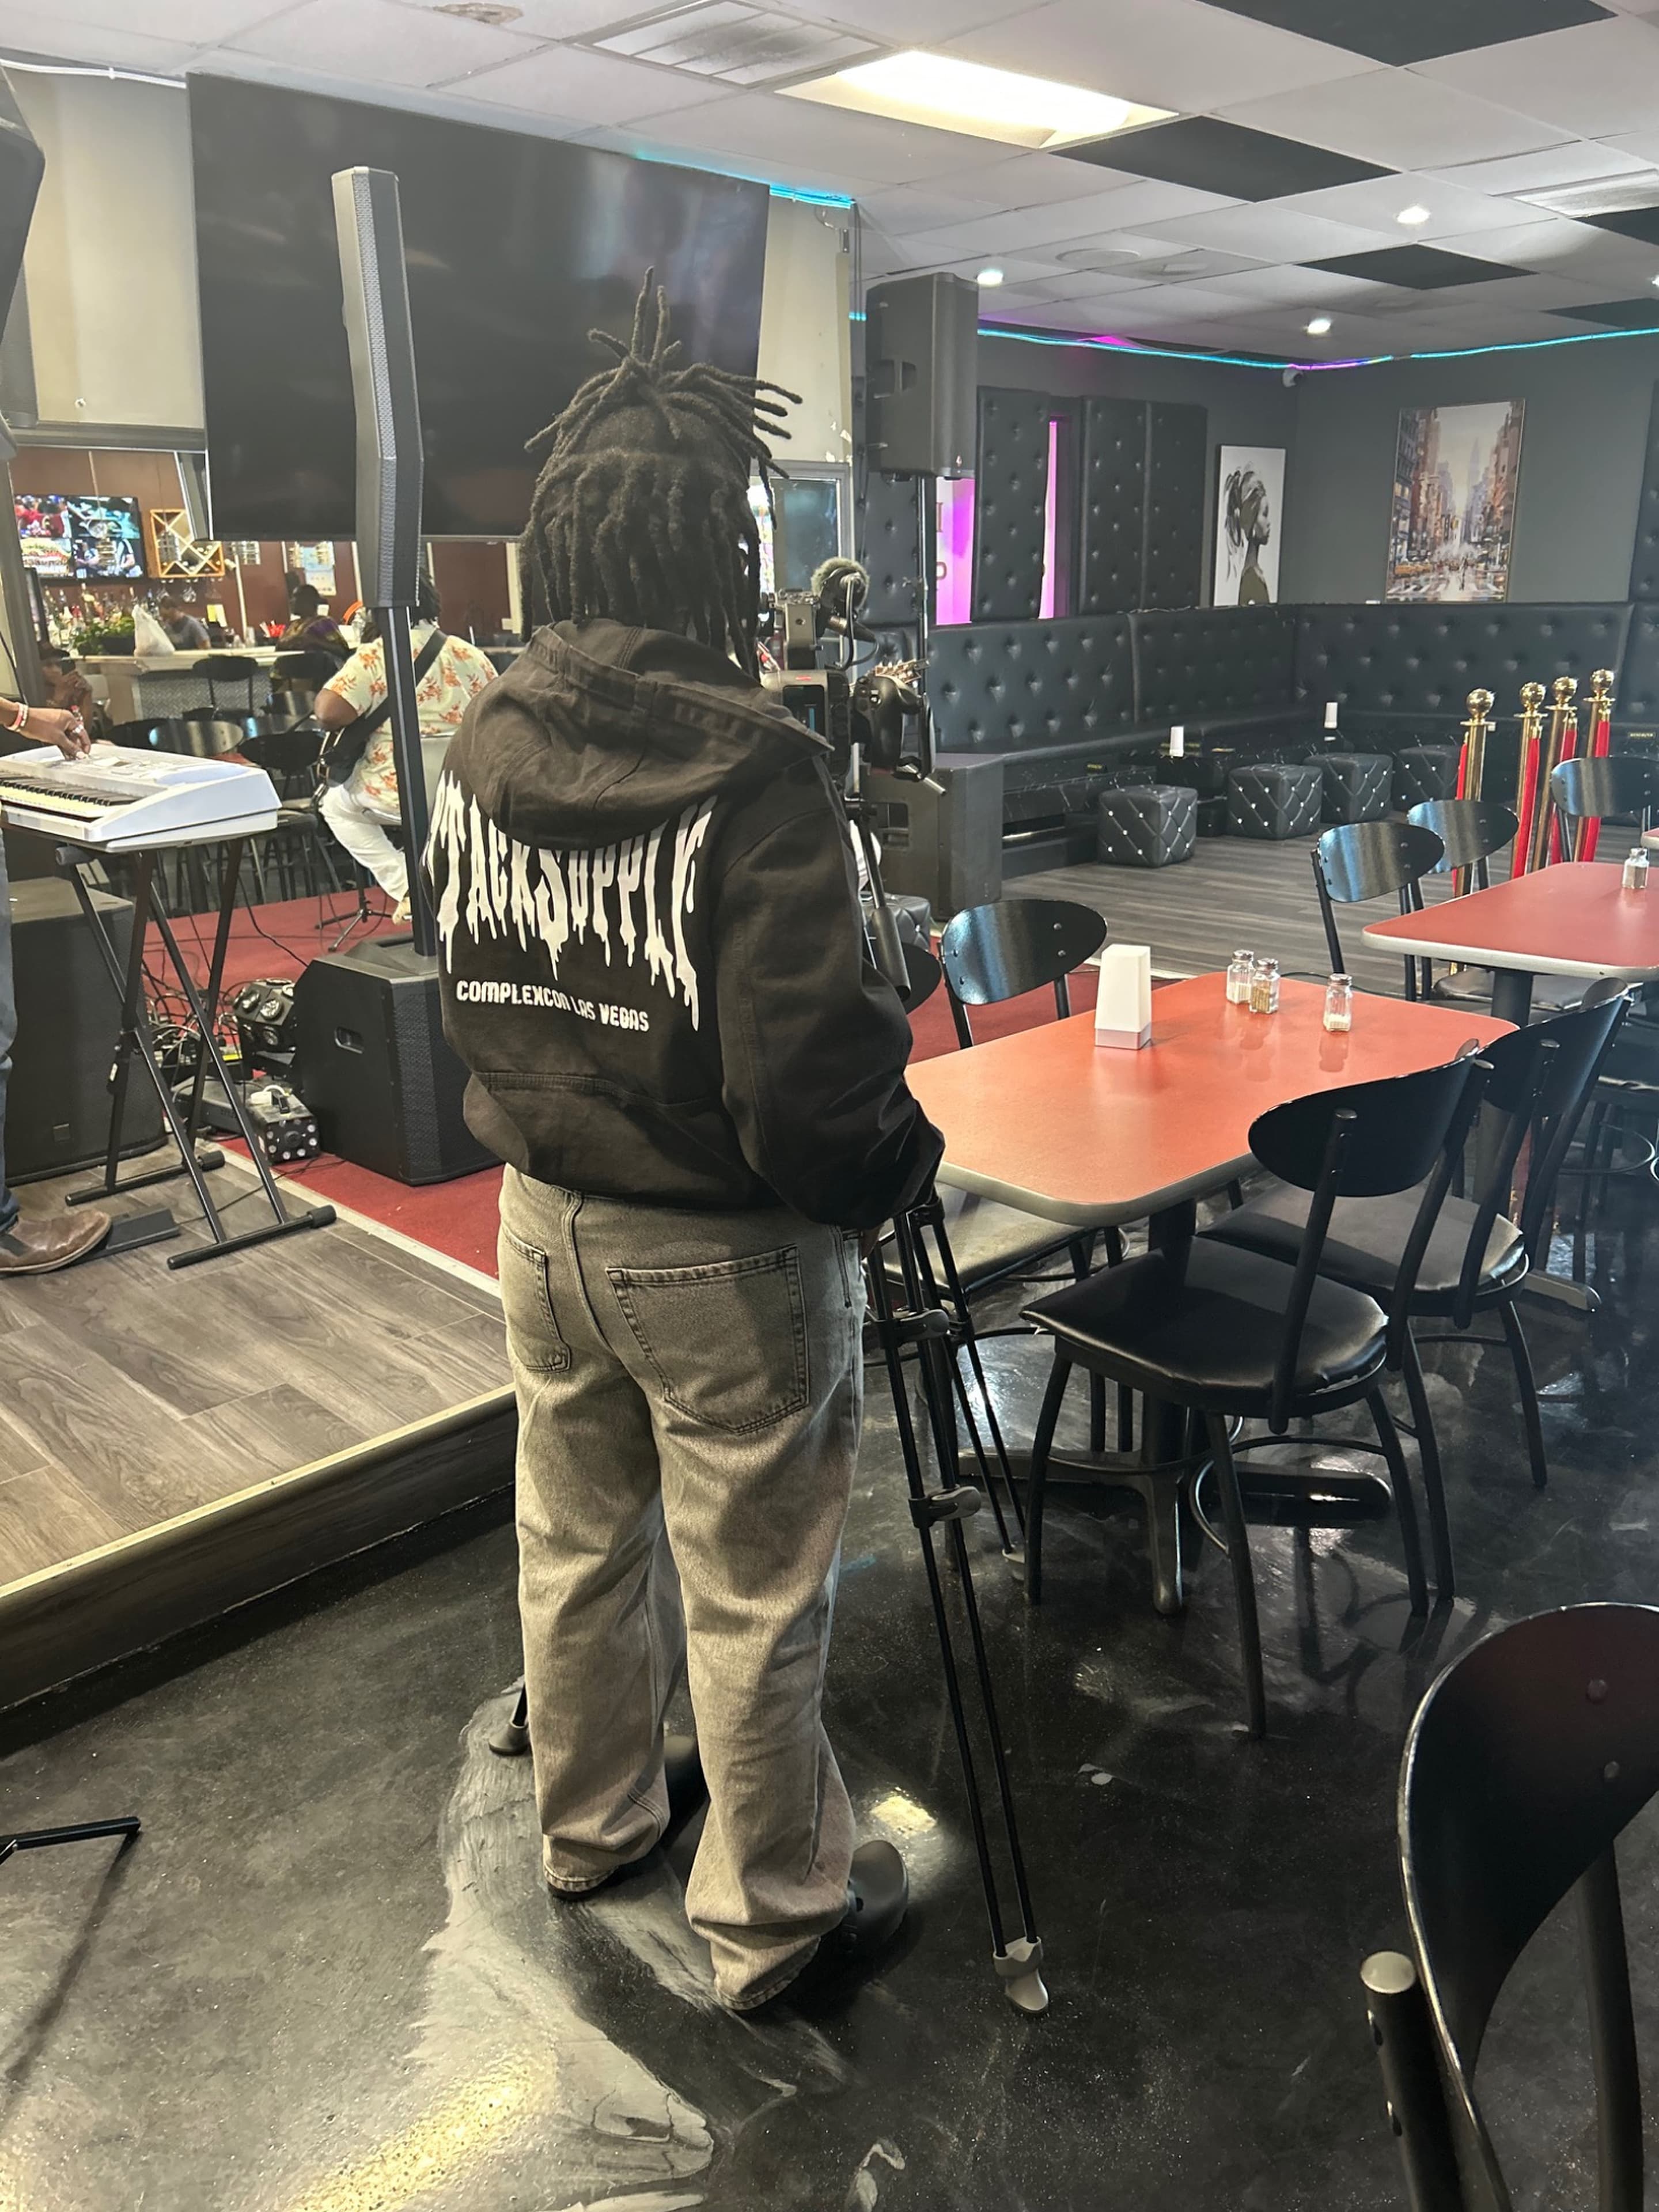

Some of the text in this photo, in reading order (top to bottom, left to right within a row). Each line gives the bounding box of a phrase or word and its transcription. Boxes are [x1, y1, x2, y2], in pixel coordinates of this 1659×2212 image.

[456, 980, 649, 1032] COMPLEXCON LAS VEGAS
